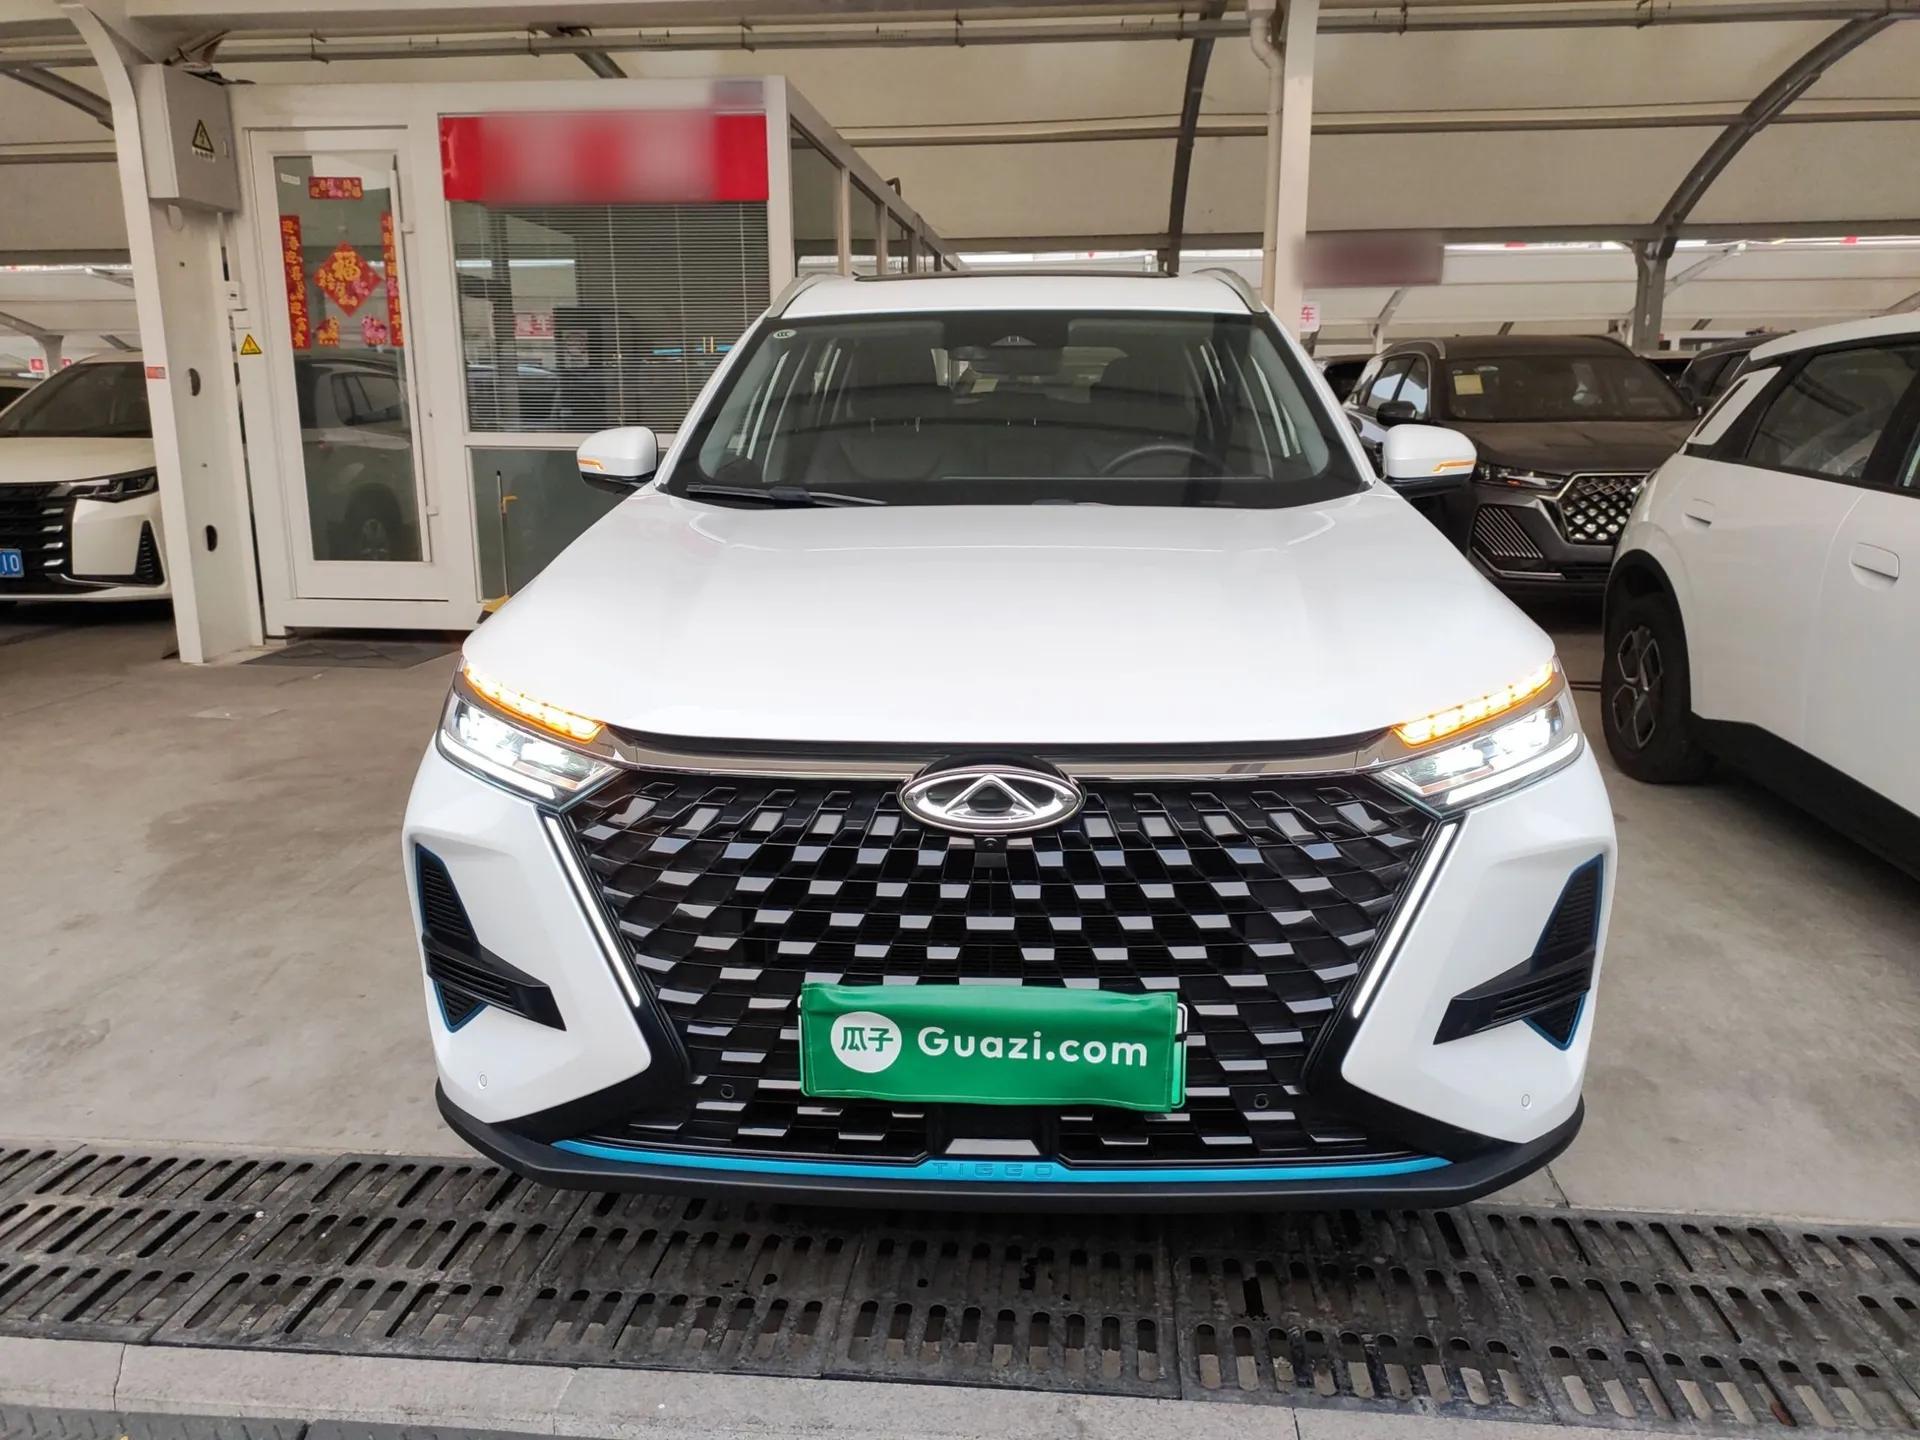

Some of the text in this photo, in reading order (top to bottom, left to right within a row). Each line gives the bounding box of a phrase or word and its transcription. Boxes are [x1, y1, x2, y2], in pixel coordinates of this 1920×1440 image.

[841, 1026, 1148, 1067] 瓜子 Guazi.com
[932, 1162, 1053, 1178] TIGGO
